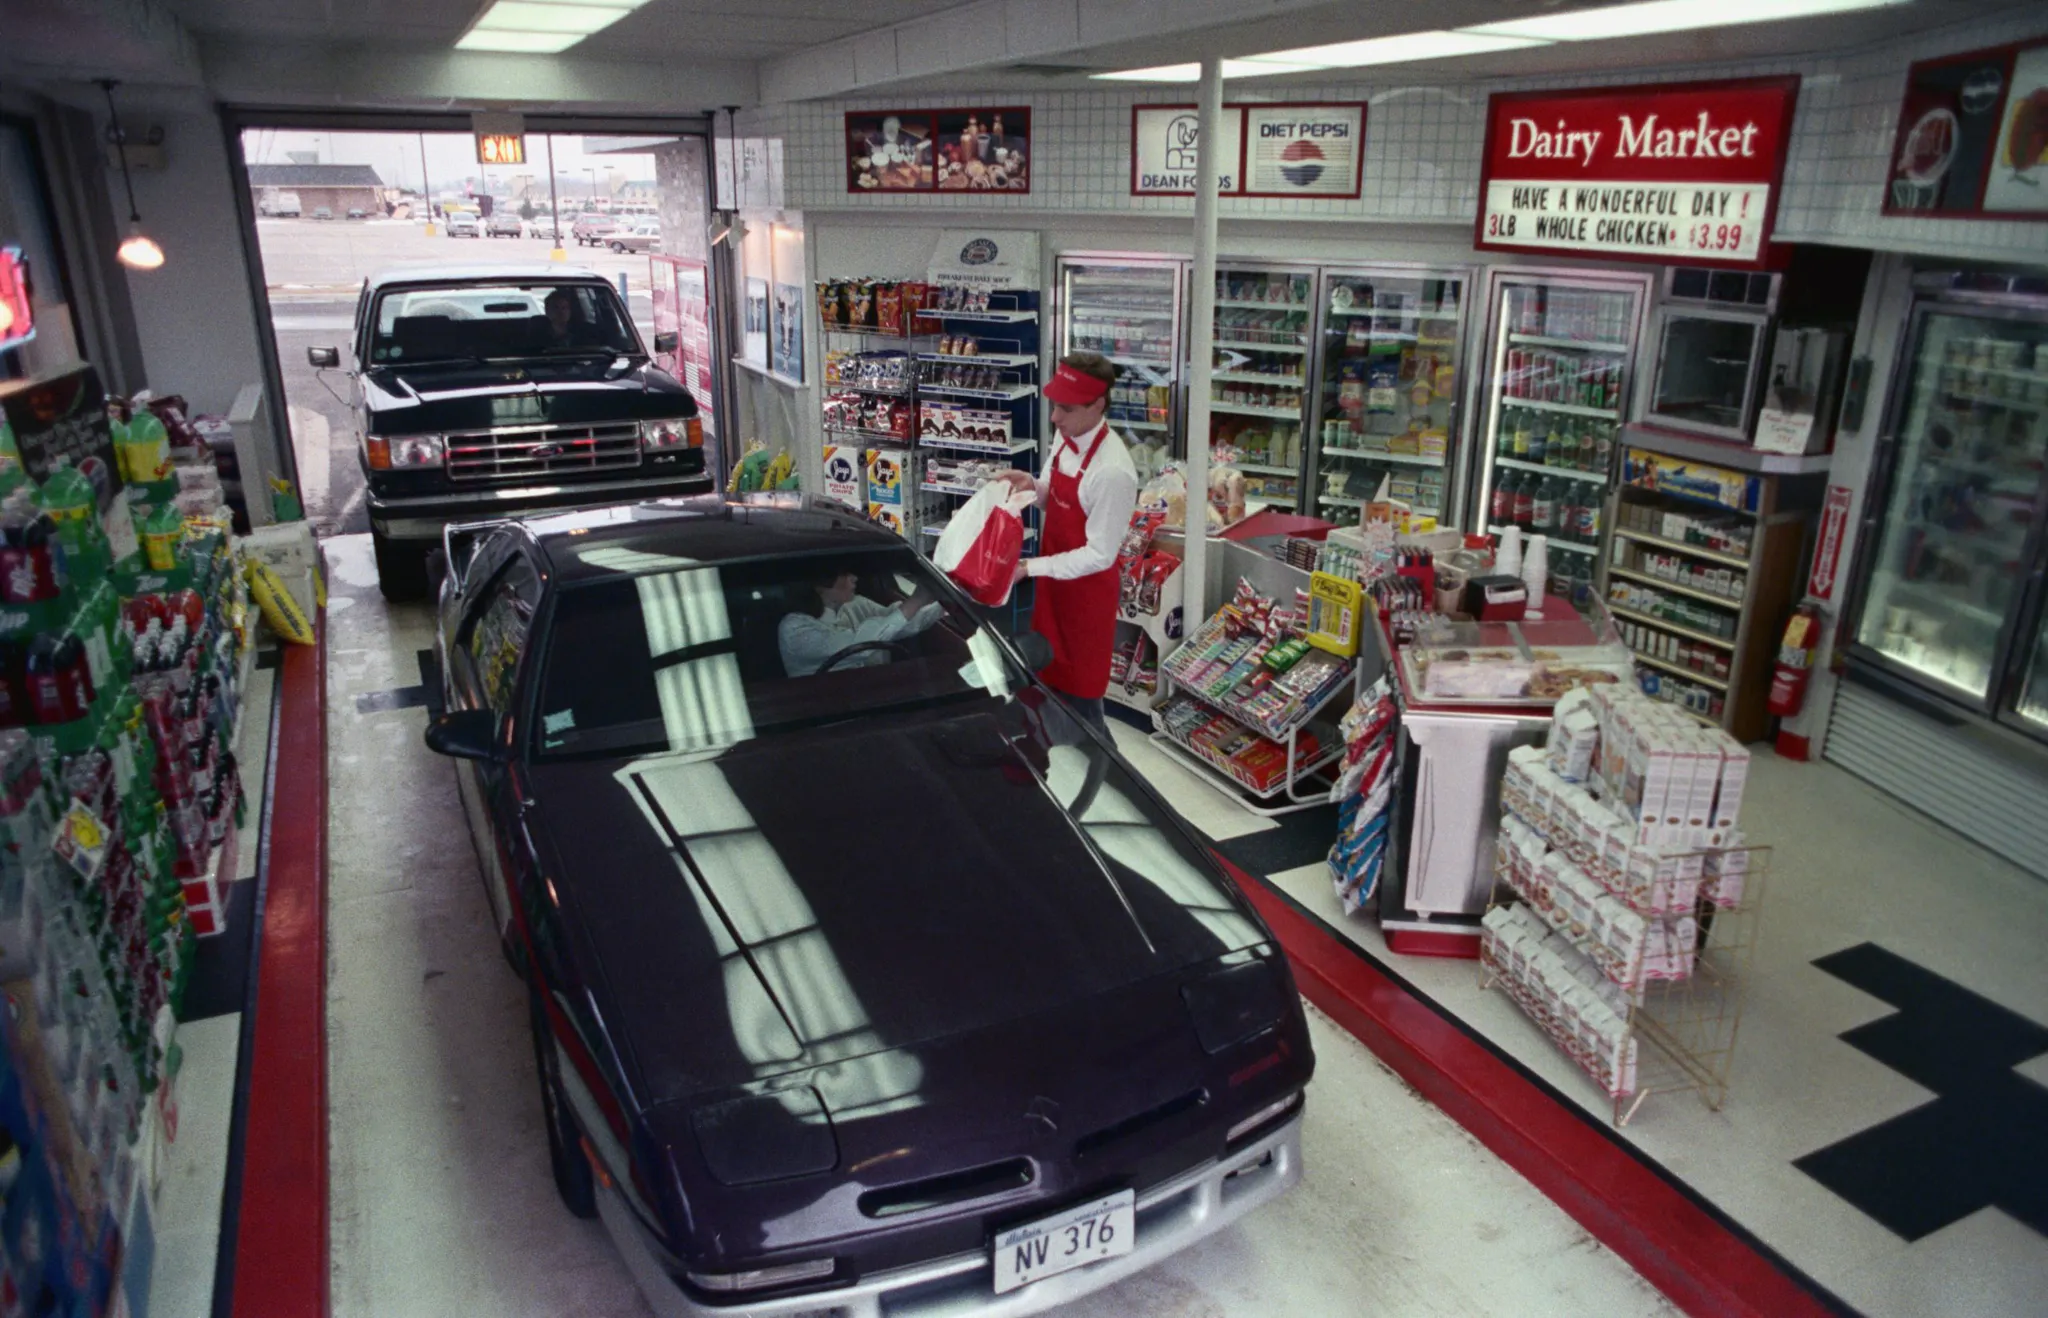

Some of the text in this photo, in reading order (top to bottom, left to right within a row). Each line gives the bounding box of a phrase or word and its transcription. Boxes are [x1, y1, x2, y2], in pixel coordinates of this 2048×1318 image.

[1260, 123, 1349, 138] DIET PEPSI
[1508, 111, 1757, 167] Dairy Market
[481, 135, 519, 162] EXIT
[1142, 174, 1179, 188] DEAN
[1512, 187, 1549, 210] HAVE
[1559, 188, 1568, 211] A
[1575, 188, 1678, 216] WONDERFUL
[1691, 191, 1731, 217] DAY
[1489, 213, 1516, 236] 3LB
[1536, 215, 1588, 240] WHOLE
[1689, 223, 1742, 251] $3.99
[829, 483, 855, 491] POTATO
[1016, 1214, 1114, 1273] NV 376
